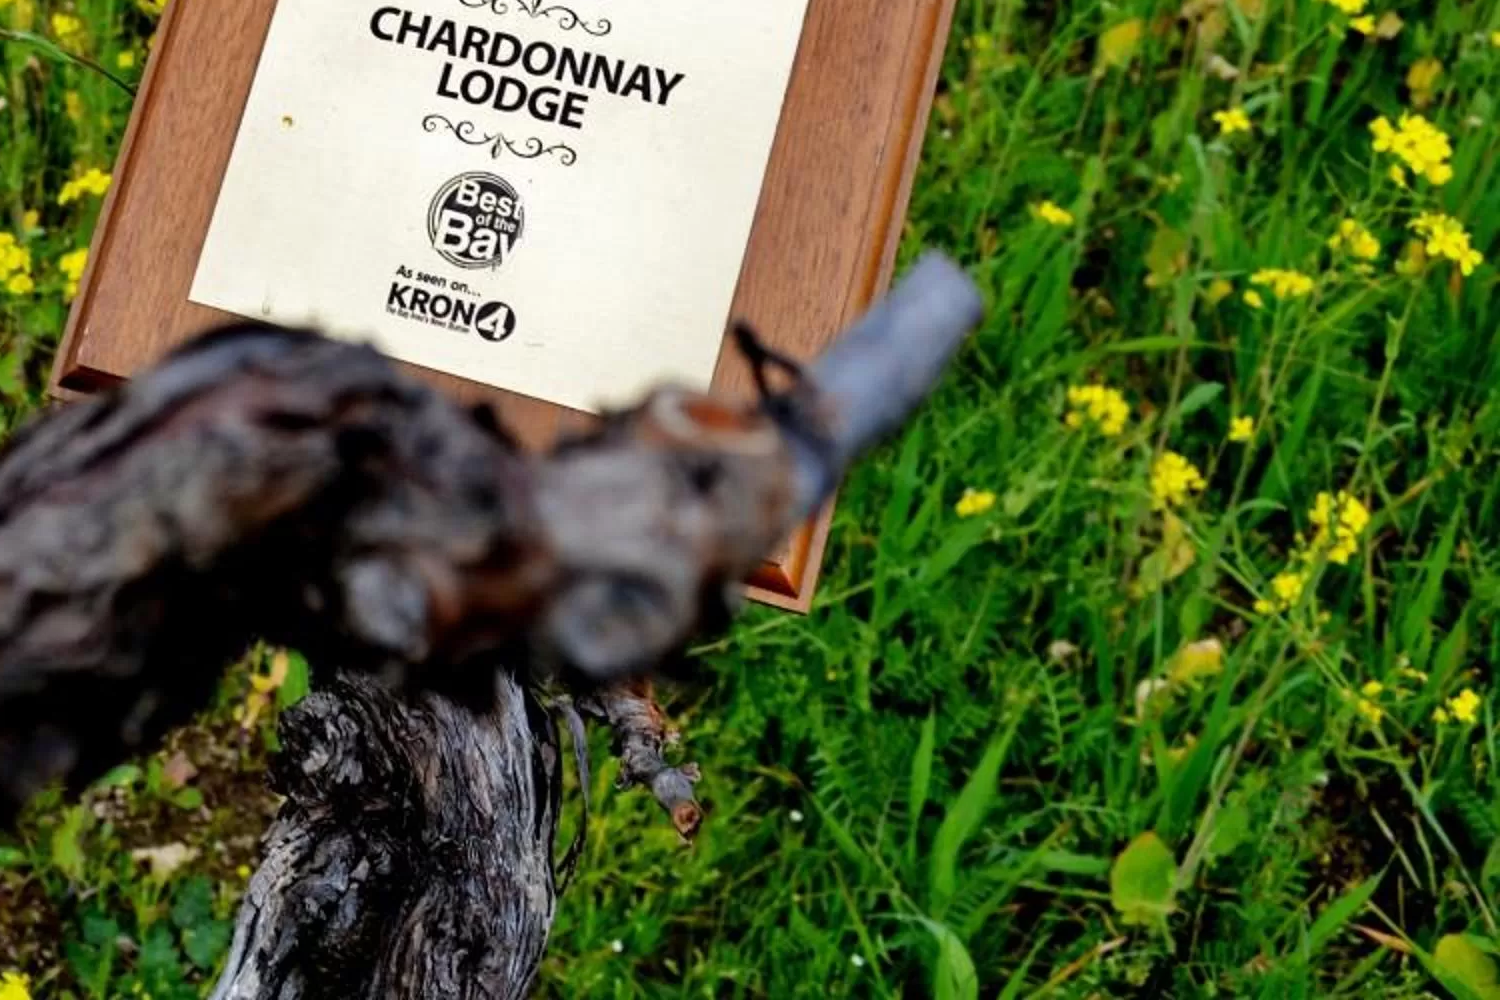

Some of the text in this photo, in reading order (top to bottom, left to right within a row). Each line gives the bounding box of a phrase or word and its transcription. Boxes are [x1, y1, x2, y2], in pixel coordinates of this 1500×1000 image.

[369, 6, 685, 106] CHARDONNAY
[436, 62, 589, 130] LODGE
[456, 178, 522, 221] Best
[475, 213, 517, 234] of the
[396, 265, 413, 279] As
[416, 271, 447, 288] seen
